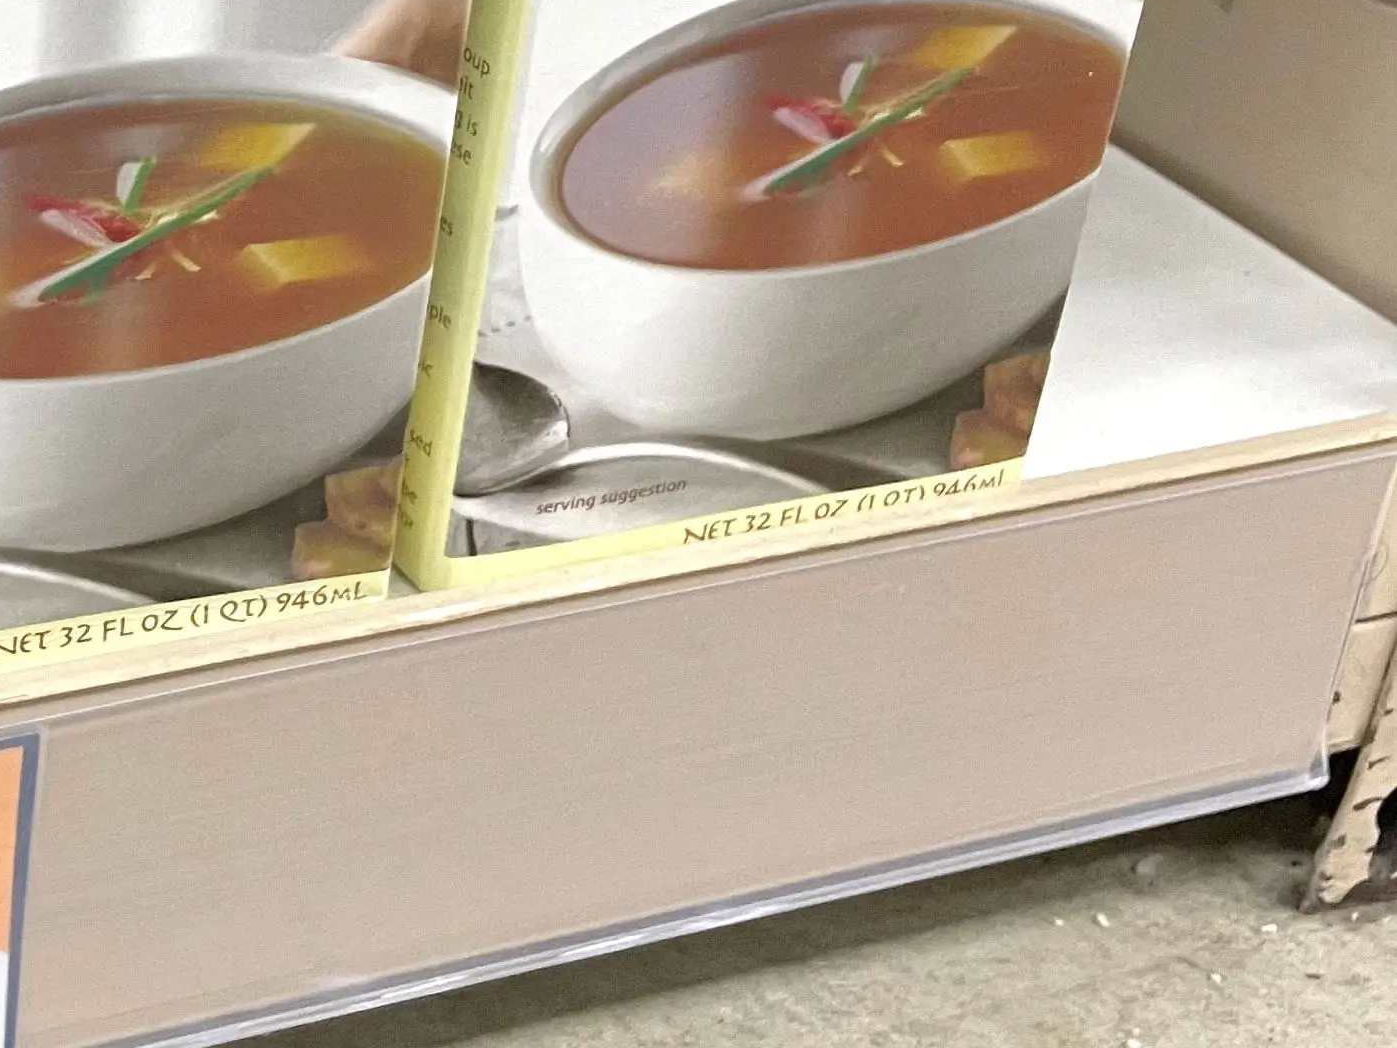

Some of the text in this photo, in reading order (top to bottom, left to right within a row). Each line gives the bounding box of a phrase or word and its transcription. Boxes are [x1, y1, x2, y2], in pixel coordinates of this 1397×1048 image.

[535, 480, 686, 514] serving suggestion
[683, 518, 737, 544] NET
[742, 512, 771, 533] 32
[780, 505, 808, 526] FL
[59, 624, 92, 648] 32
[103, 617, 133, 642] FL
[142, 610, 183, 632] OZ
[219, 595, 267, 623] QT)
